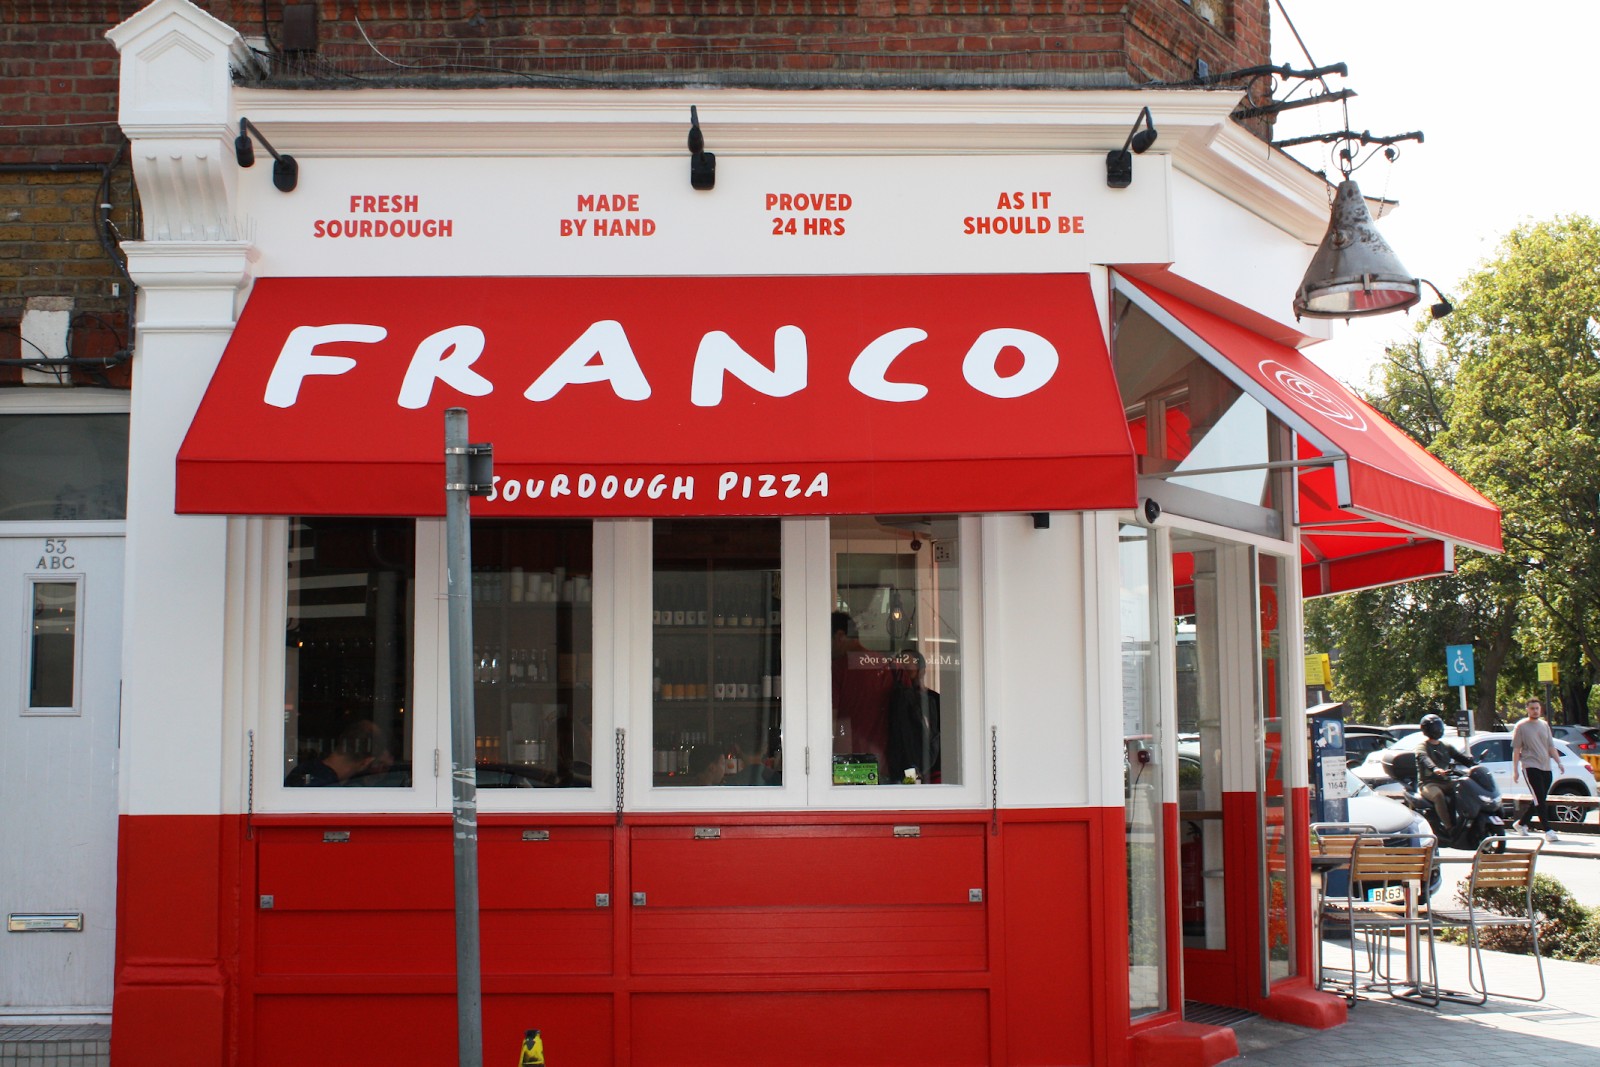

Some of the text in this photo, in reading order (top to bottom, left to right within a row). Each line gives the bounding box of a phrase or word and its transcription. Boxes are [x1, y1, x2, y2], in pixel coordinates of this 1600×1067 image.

[350, 194, 419, 213] FRESH
[577, 193, 639, 213] MADE
[765, 193, 852, 212] PROVED
[997, 192, 1052, 211] AS IT
[314, 219, 453, 239] SOURDOUGH
[560, 218, 656, 237] BY HAND
[772, 218, 846, 236] 24 HRS
[963, 215, 1085, 235] SHOULD BE
[263, 319, 1060, 410] FRANCO
[486, 471, 829, 502] SOURDOUGH PIZZA
[45, 538, 67, 554] 53
[36, 556, 75, 570] ABC
